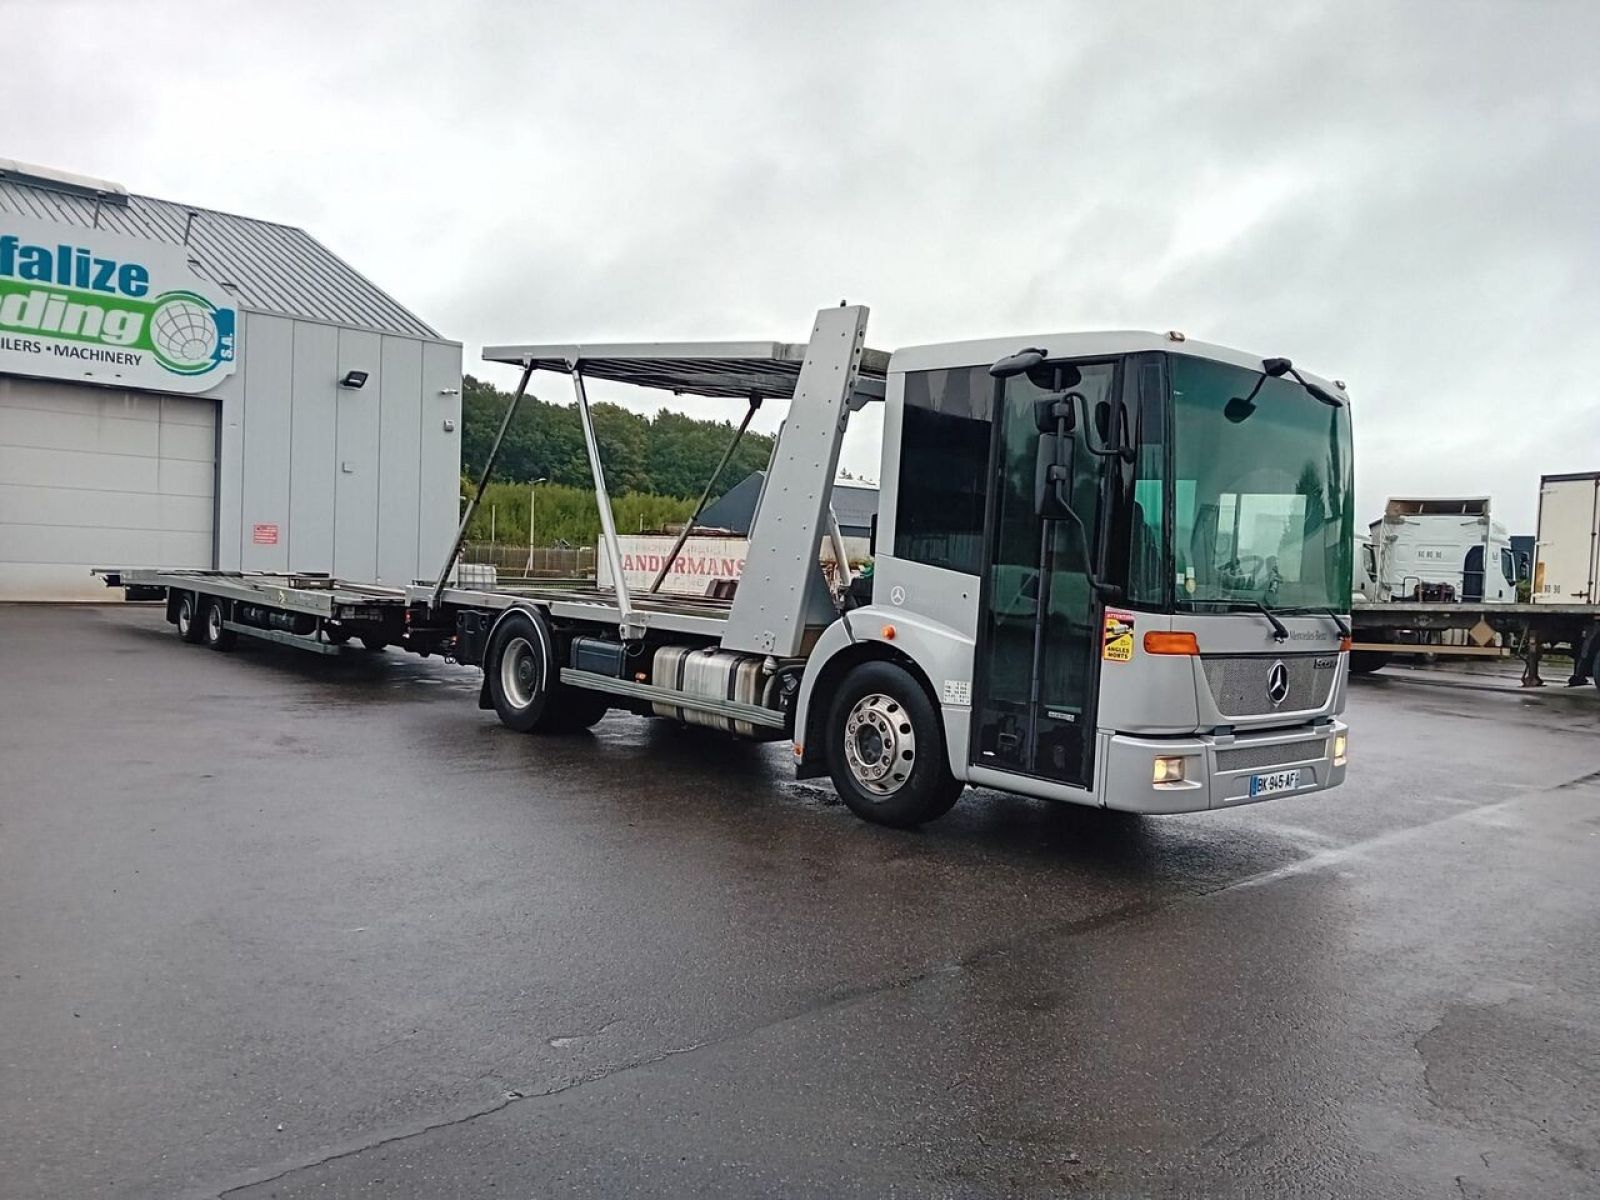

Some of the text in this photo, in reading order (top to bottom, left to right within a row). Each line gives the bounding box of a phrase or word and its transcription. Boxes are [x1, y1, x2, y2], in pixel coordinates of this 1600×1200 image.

[0, 290, 145, 345] ding
[54, 344, 142, 366] MACHINERY
[220, 333, 233, 359] S.A.
[621, 553, 745, 577] ANDERMANS
